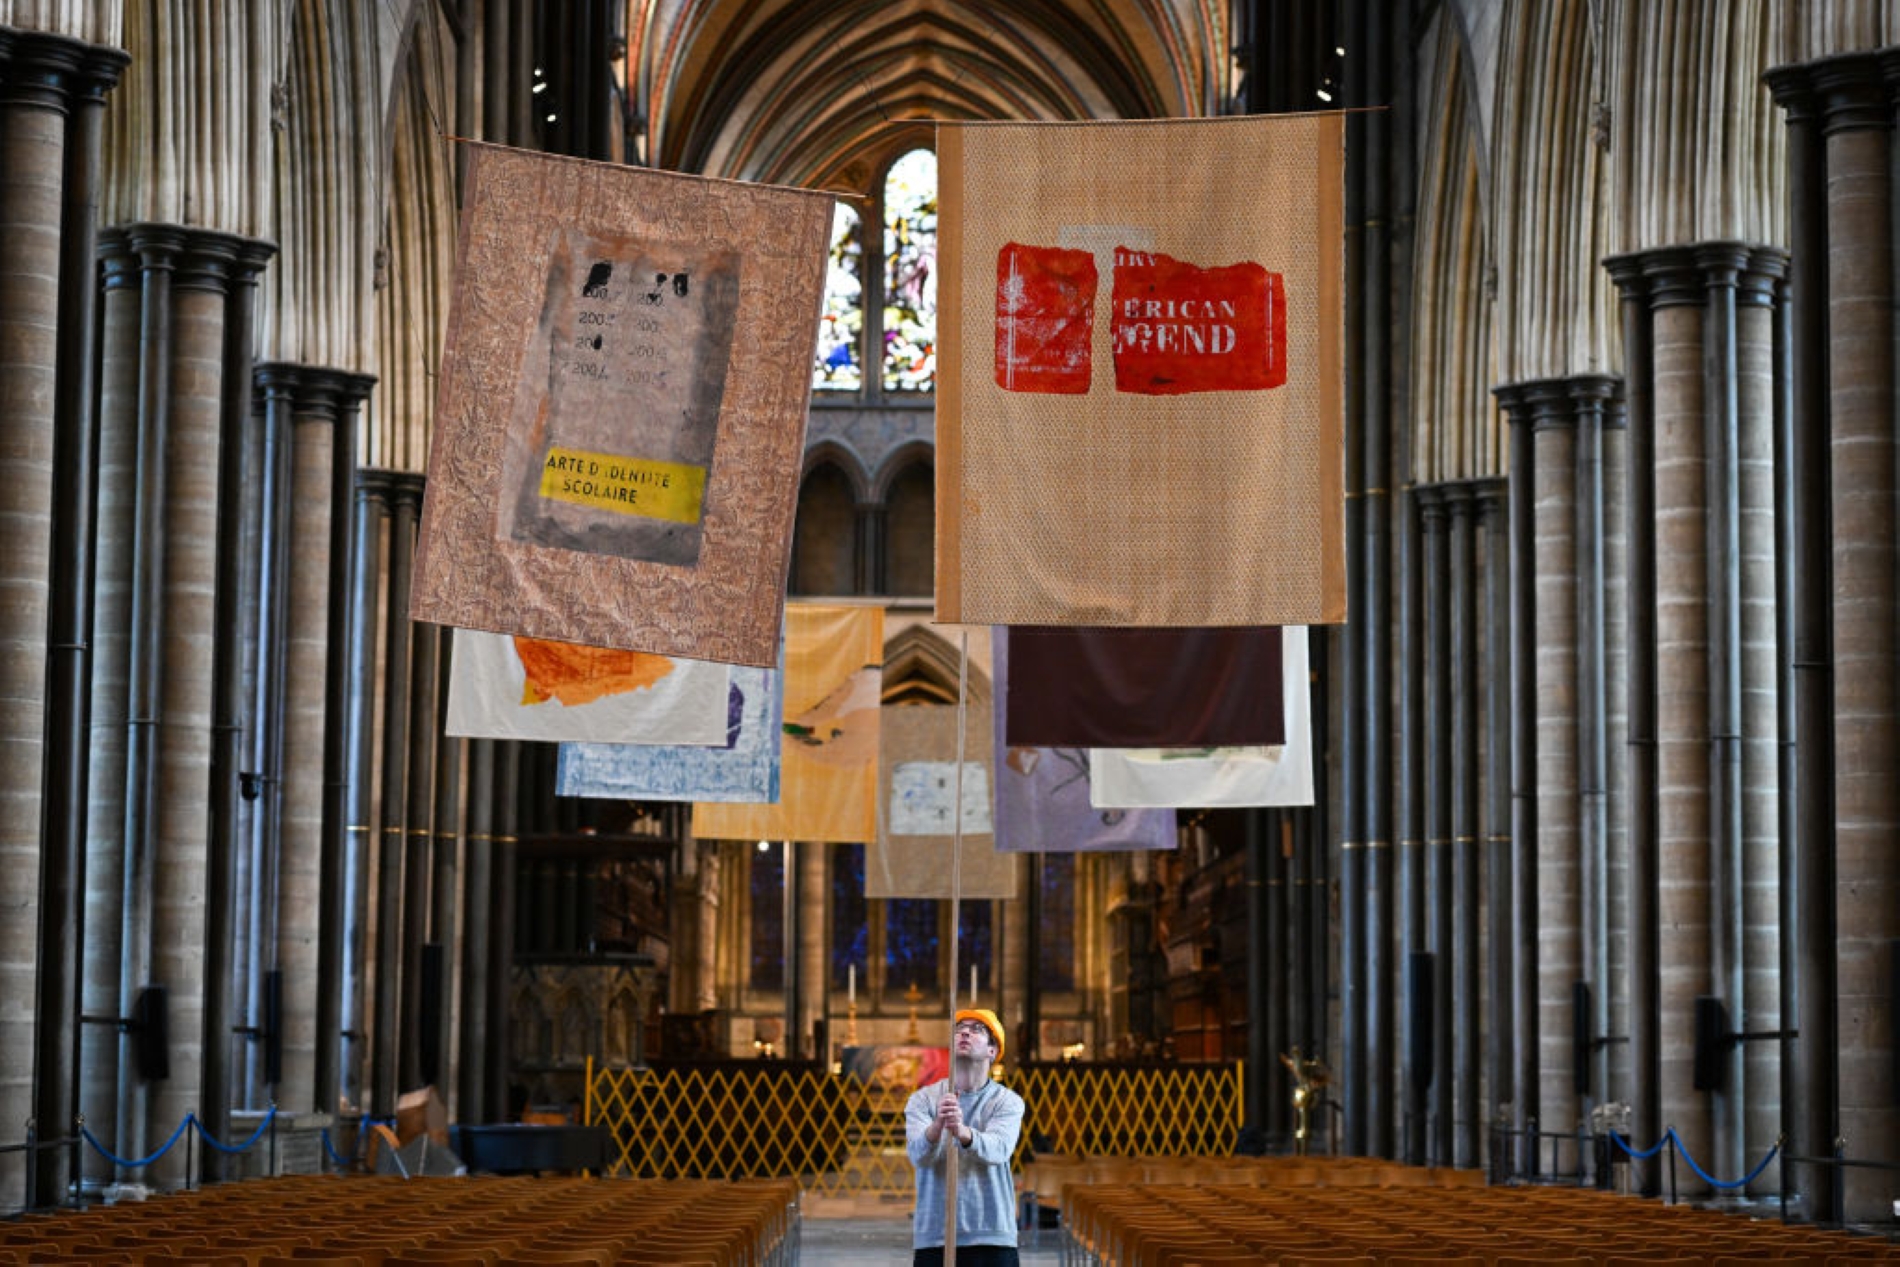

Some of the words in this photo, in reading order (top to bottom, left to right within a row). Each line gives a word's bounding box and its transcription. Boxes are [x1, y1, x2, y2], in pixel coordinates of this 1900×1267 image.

[576, 334, 602, 351] 20
[547, 455, 585, 475] ARTE
[562, 477, 638, 505] SCOLAIRE
